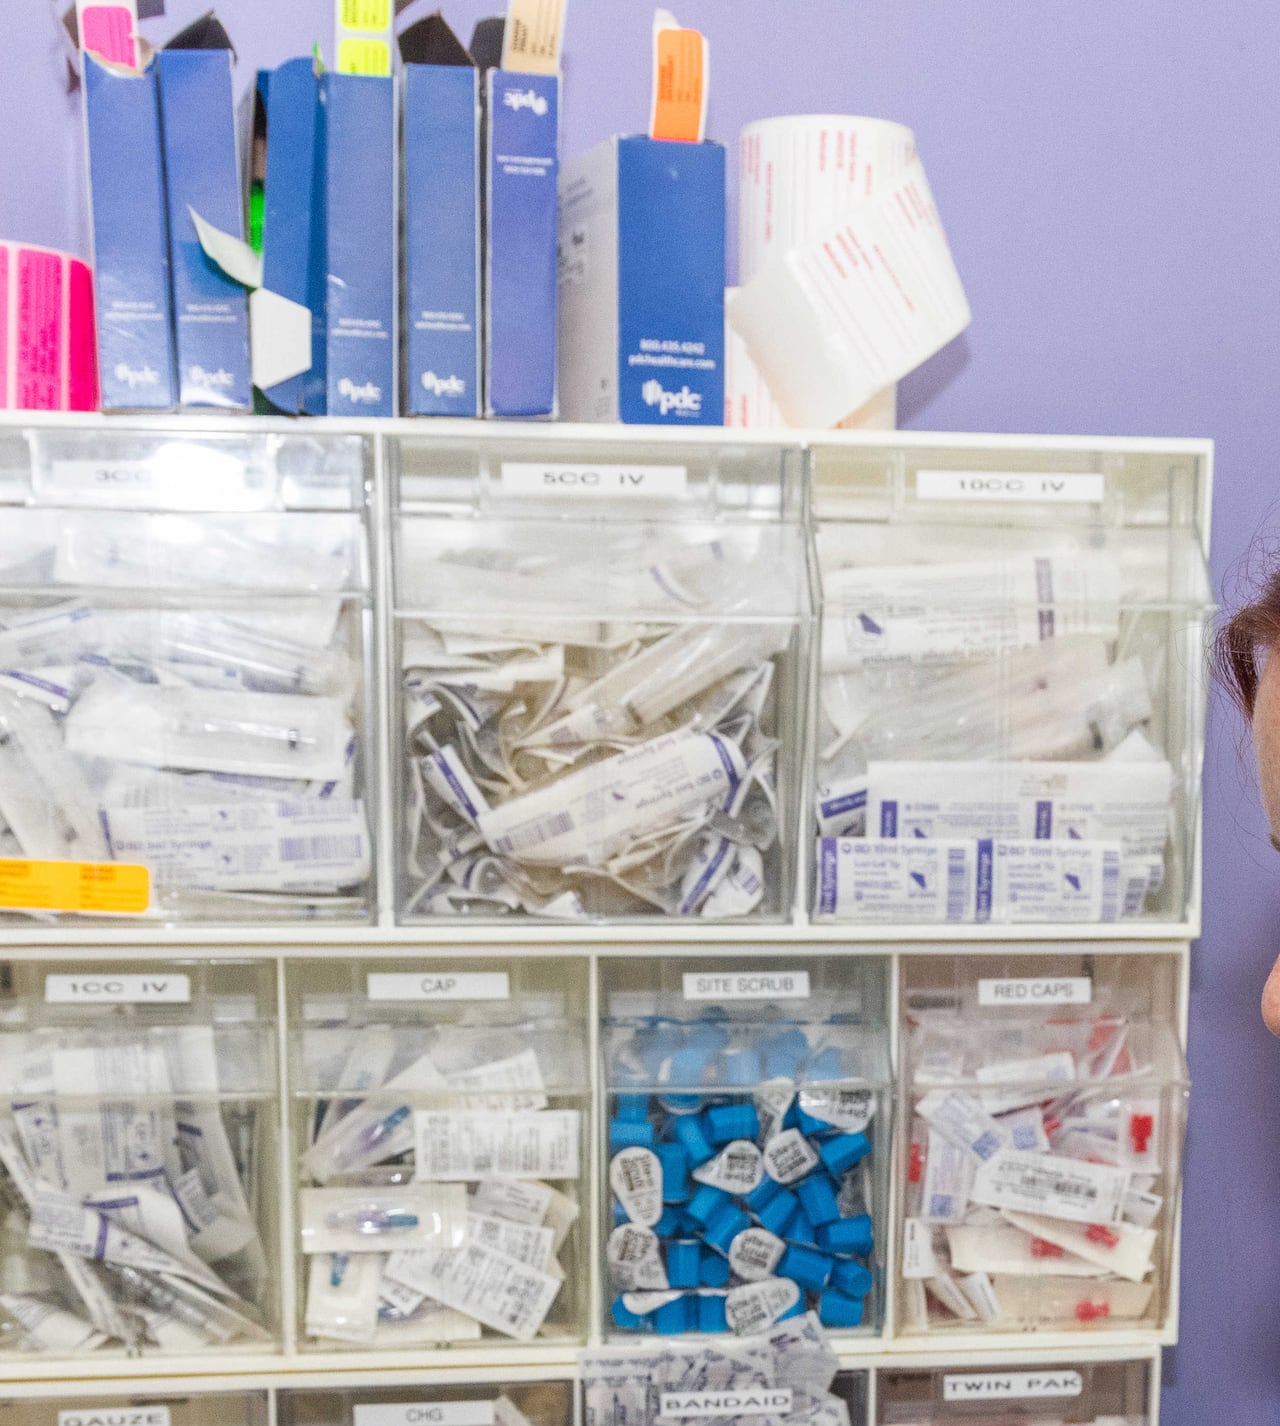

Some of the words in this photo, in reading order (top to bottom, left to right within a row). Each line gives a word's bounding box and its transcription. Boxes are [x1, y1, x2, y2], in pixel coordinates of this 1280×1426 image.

[659, 385, 703, 417] pdc
[619, 472, 644, 485] IV
[960, 478, 1024, 491] 10CC
[1041, 480, 1064, 491] IV
[71, 982, 124, 994] 1CC
[142, 982, 168, 993] IV
[420, 978, 456, 994] CAP
[696, 978, 733, 994] SITE
[737, 976, 794, 993] SCRUB
[994, 983, 1027, 999] RED
[1031, 982, 1074, 998] CAPS
[950, 1381, 1012, 1392] TWIN
[1027, 1378, 1078, 1390] PAK
[665, 1396, 790, 1410] BANDAID
[405, 1407, 443, 1422] CHG
